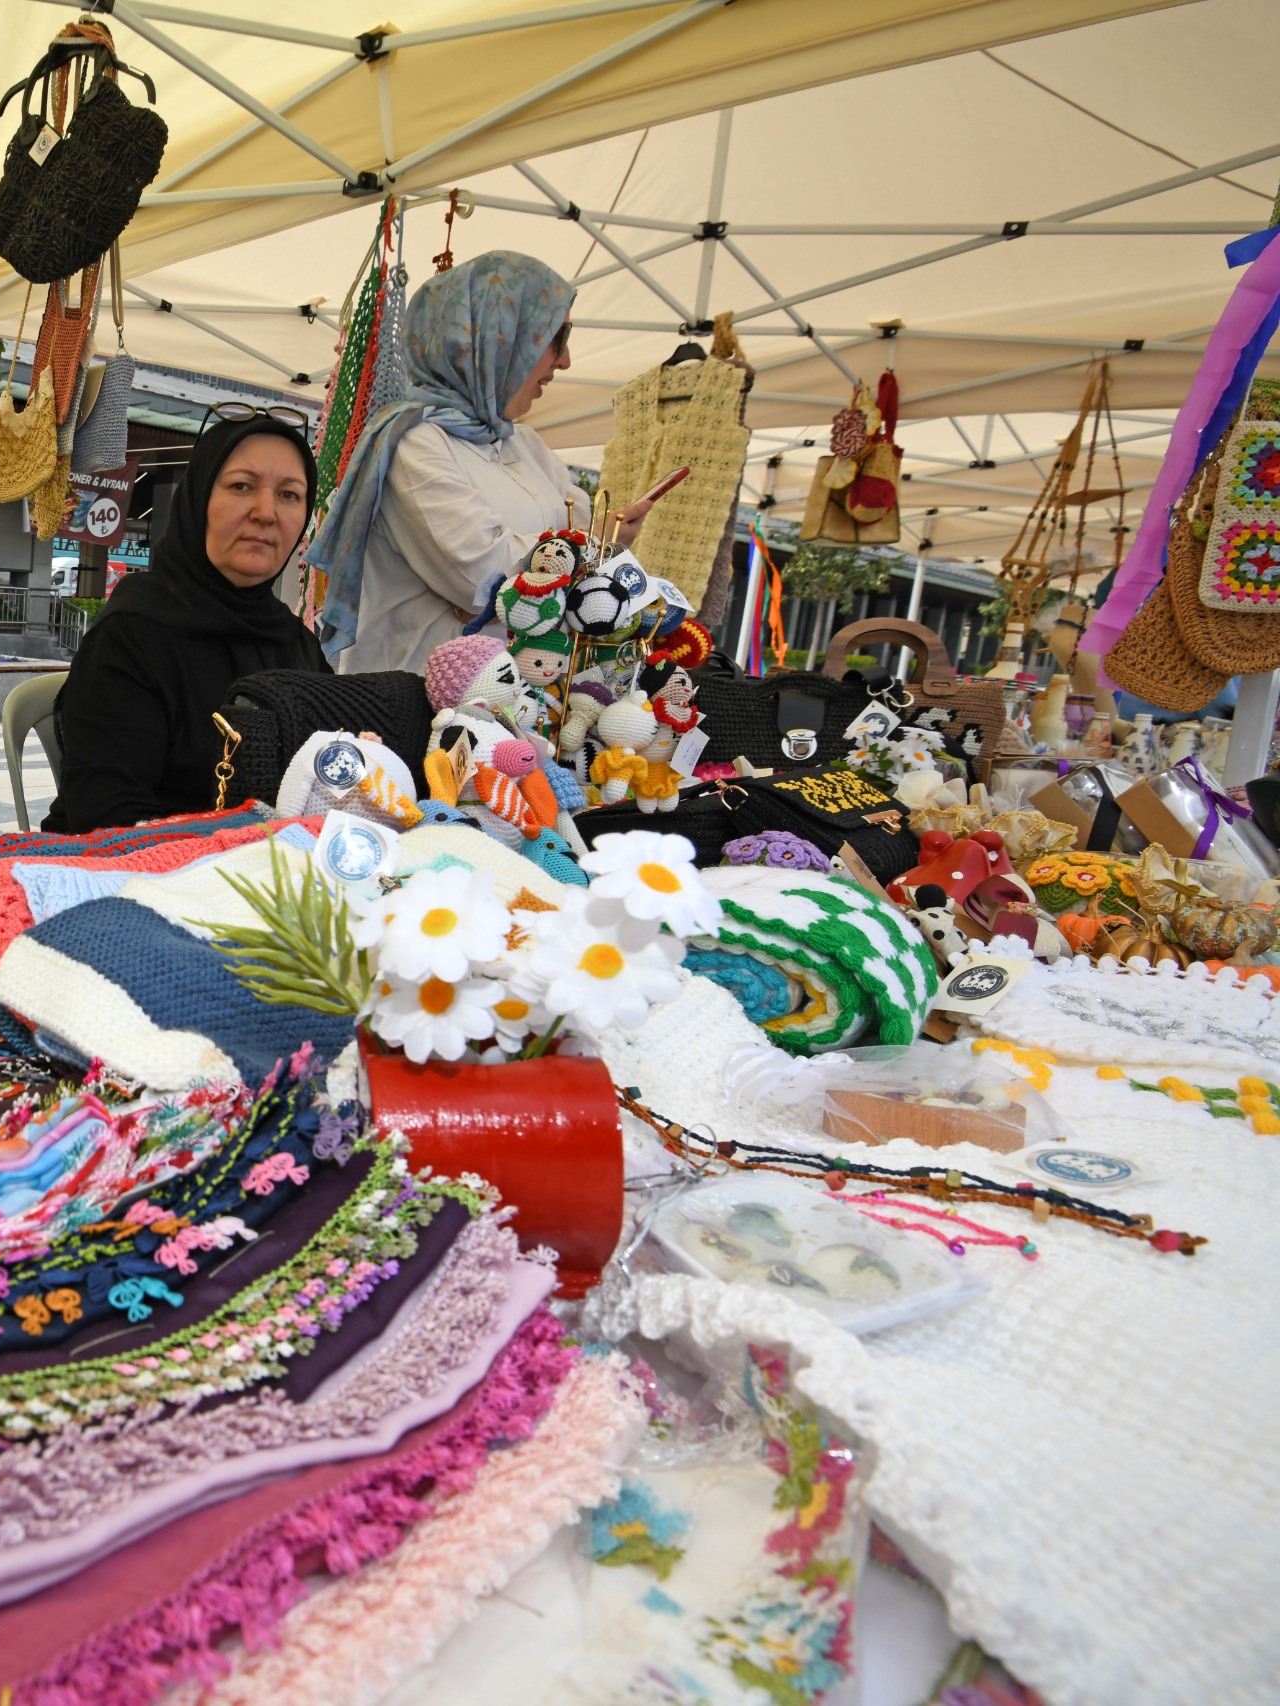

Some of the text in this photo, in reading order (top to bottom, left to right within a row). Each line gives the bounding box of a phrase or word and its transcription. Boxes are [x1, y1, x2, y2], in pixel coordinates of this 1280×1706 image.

[92, 476, 100, 487] &
[100, 478, 129, 491] AYRAN
[89, 507, 119, 525] 140
